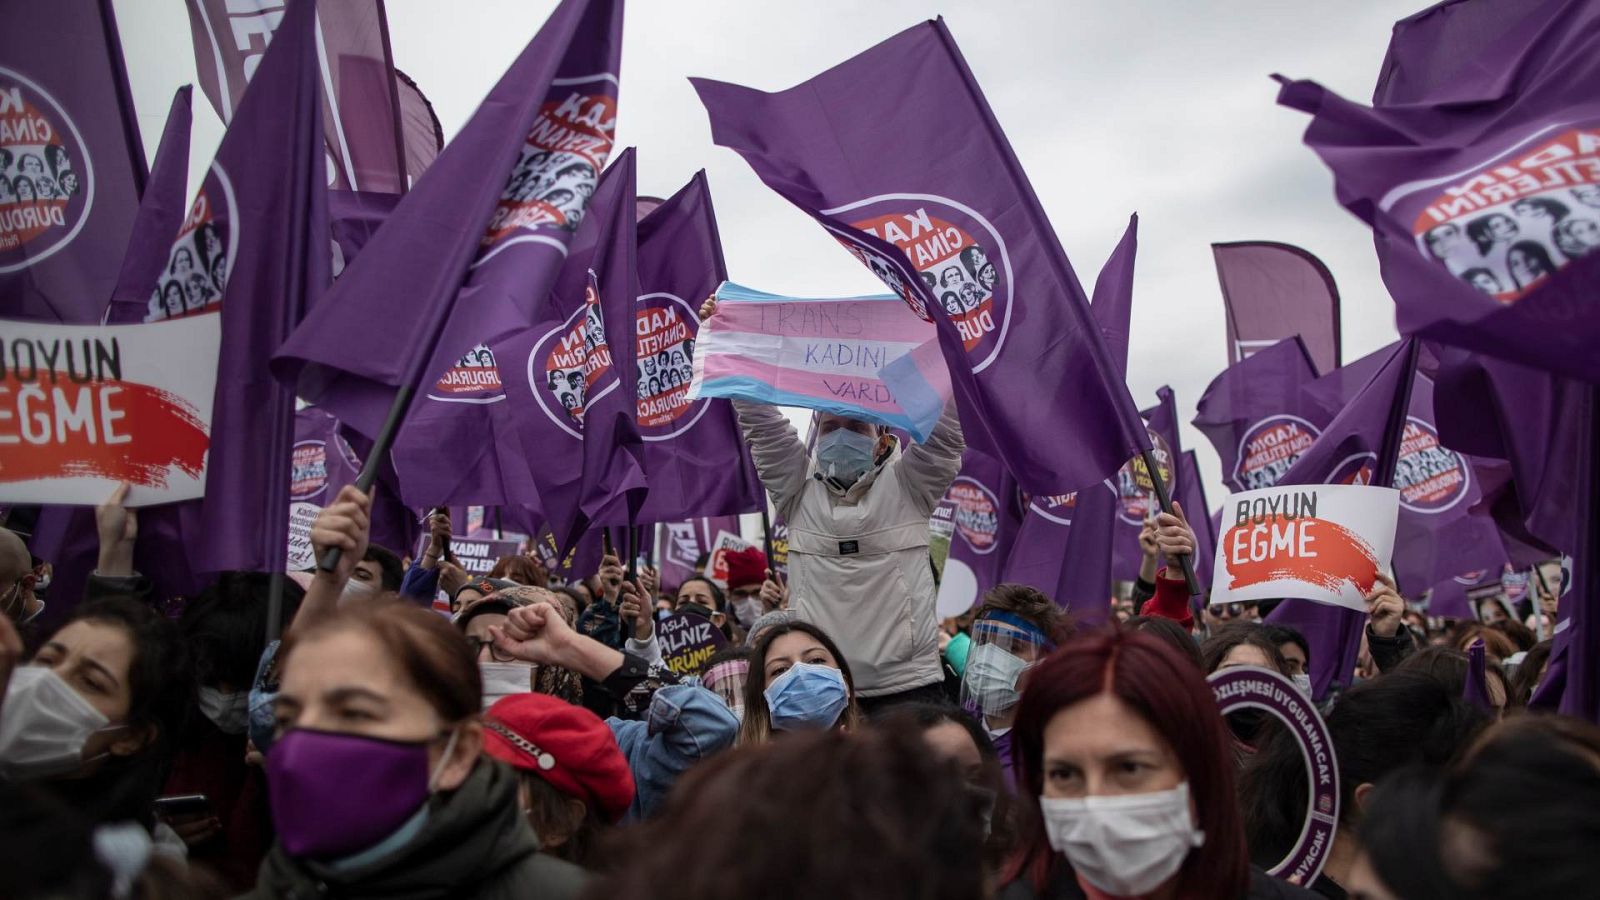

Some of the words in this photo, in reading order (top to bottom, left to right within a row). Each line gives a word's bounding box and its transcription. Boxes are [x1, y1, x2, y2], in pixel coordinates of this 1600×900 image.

[757, 302, 864, 336] TRANS
[0, 336, 121, 385] OYUN
[823, 379, 897, 404] VARD
[1236, 490, 1318, 527] BOYUN
[450, 542, 490, 557] KADIN
[1232, 520, 1318, 566] EĞME
[658, 622, 713, 655] ALNIZ
[660, 616, 689, 634] ASLA
[1274, 686, 1331, 786] UYGULANACAK
